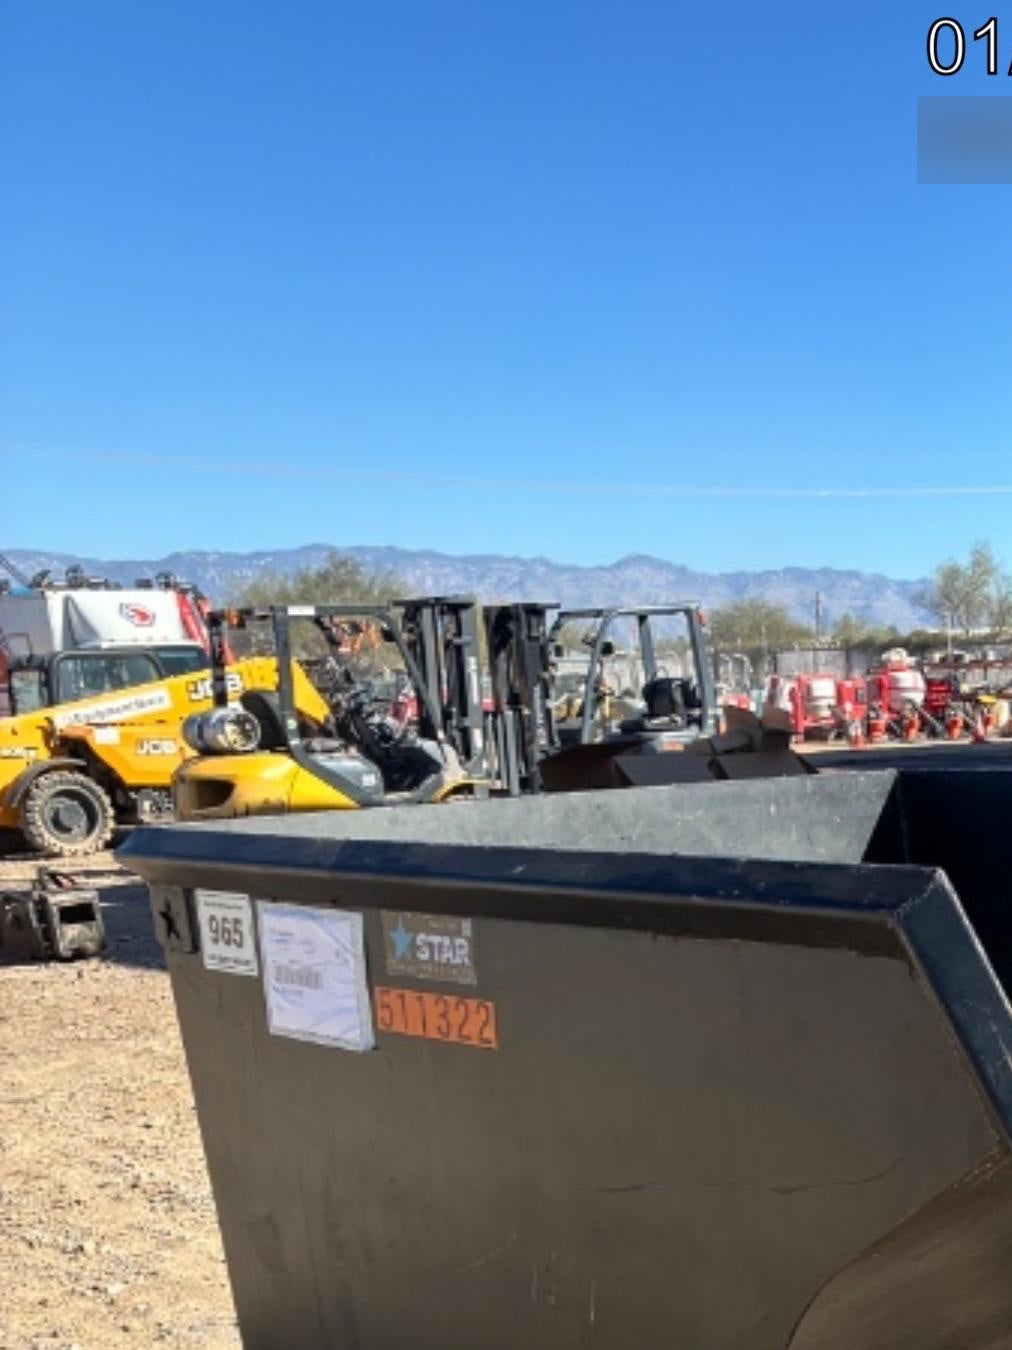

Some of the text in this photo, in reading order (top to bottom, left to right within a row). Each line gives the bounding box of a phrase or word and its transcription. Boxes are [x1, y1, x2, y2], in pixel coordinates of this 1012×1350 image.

[208, 914, 244, 949] 965
[415, 932, 470, 968] STAR
[380, 988, 493, 1045] 511322
